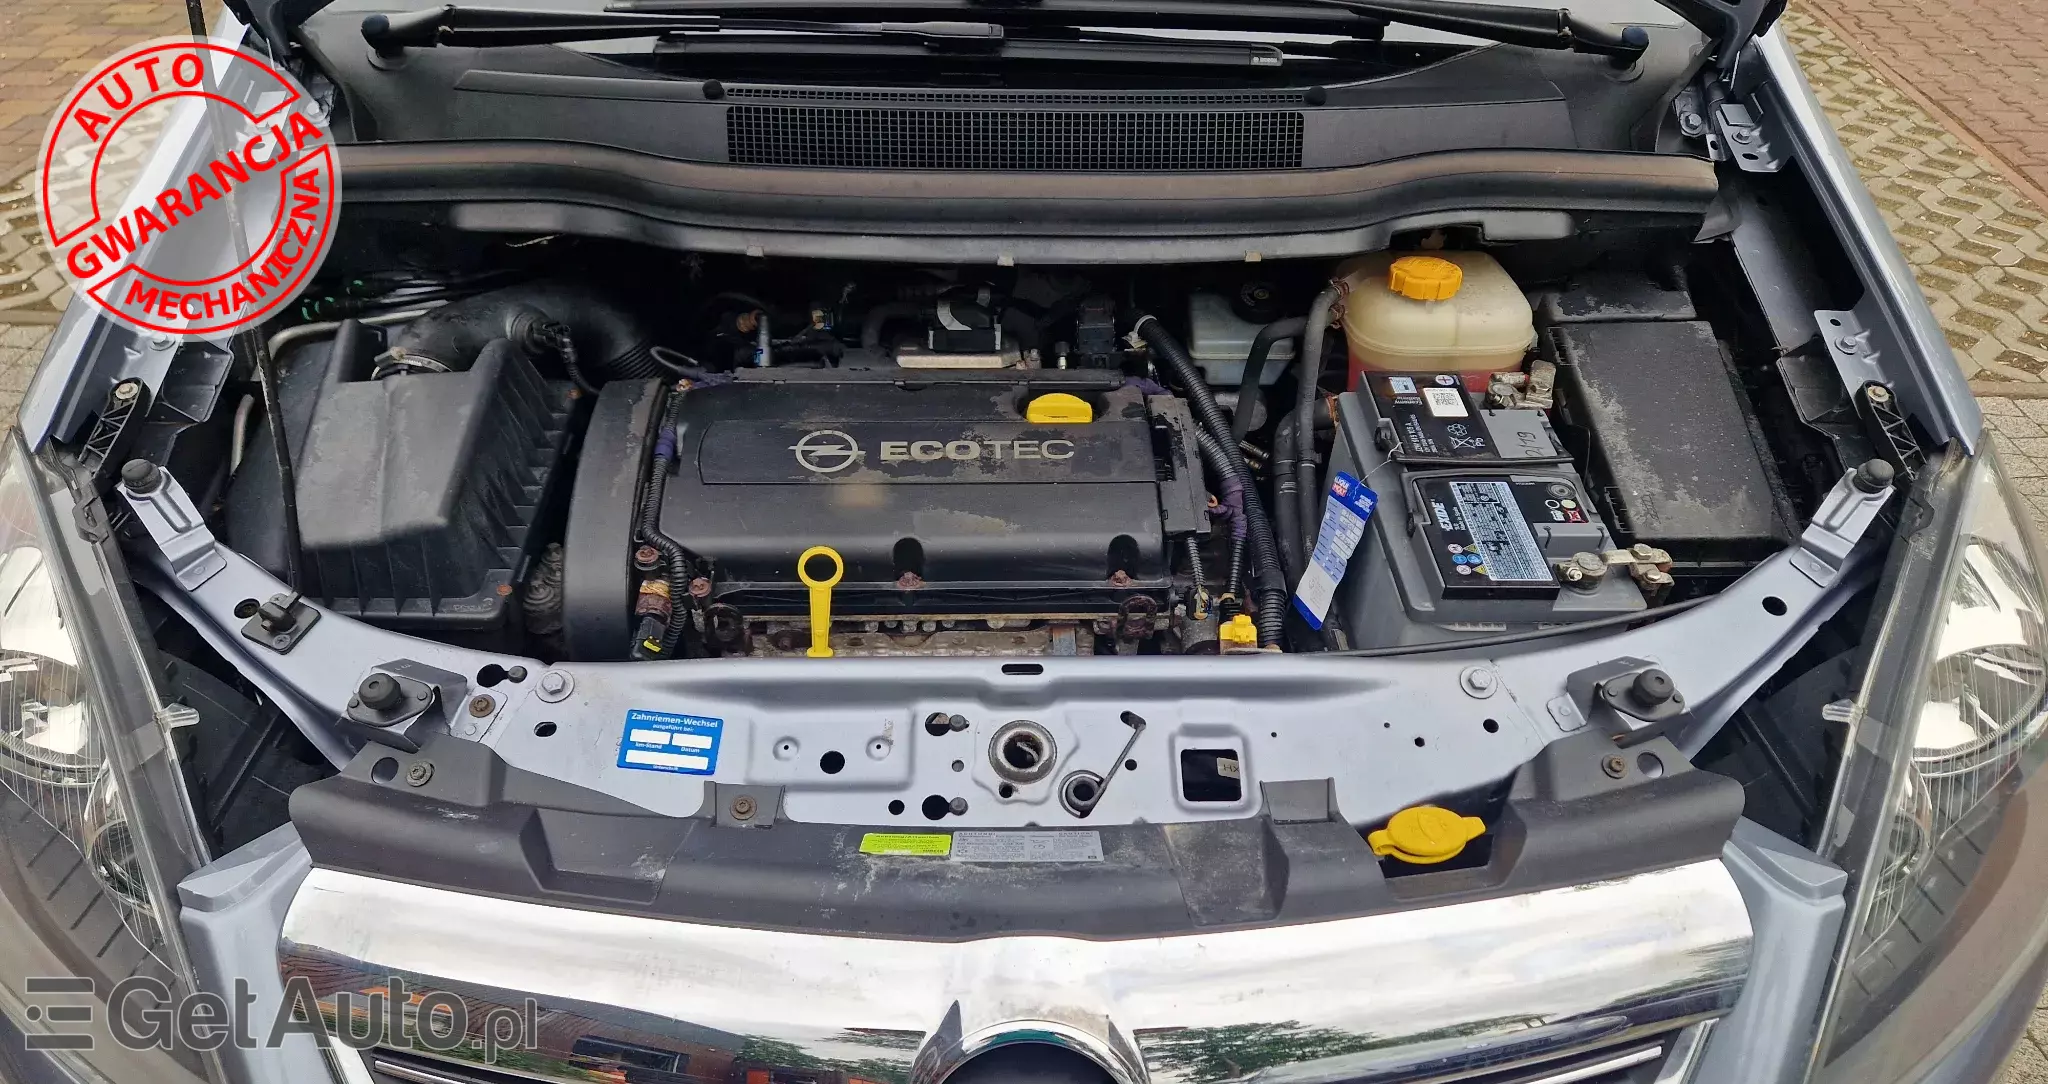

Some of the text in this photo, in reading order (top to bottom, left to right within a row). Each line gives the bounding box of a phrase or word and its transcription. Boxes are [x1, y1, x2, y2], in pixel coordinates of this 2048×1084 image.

[880, 439, 1075, 460] ECOTEC
[1432, 500, 1453, 531] EXIDE
[631, 712, 718, 728] Zahnriemen-Wechsel
[635, 742, 662, 750] km-Stand
